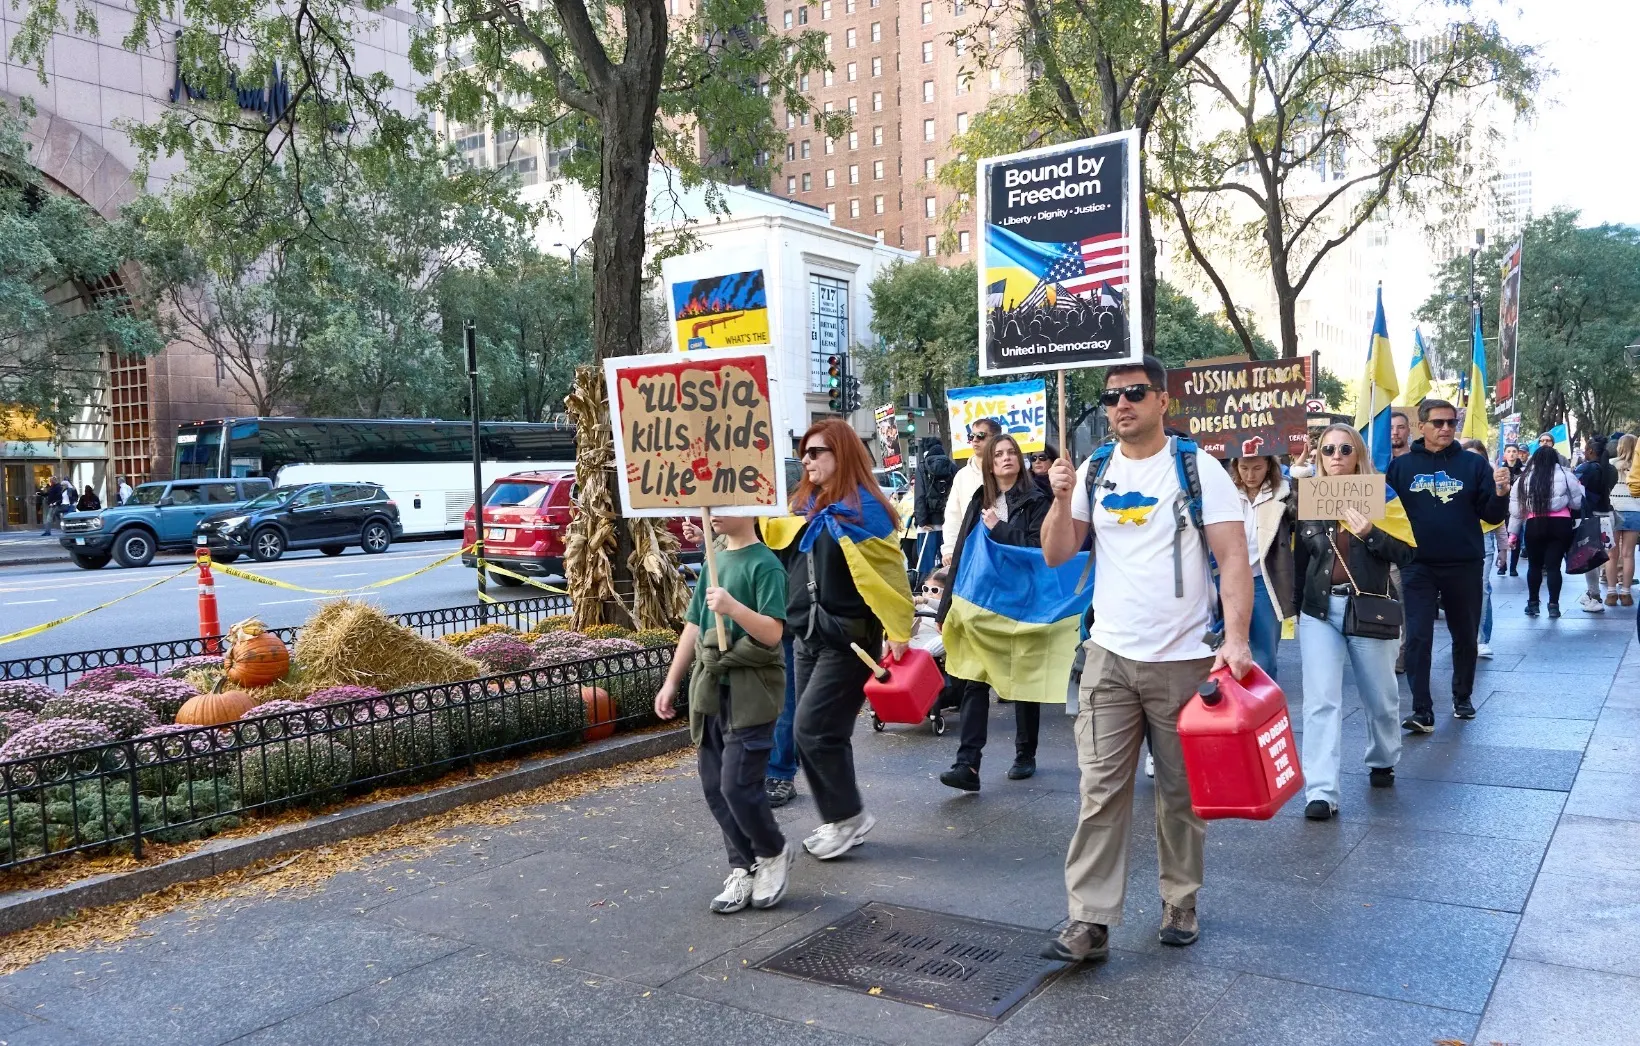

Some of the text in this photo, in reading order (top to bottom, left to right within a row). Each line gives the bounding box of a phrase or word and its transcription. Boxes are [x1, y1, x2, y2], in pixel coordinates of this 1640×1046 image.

[1005, 155, 1106, 188] Bound by
[1008, 179, 1101, 208] Freedom
[1003, 203, 1106, 226] Liberty Dignity Justice
[820, 287, 836, 301] 717
[820, 321, 838, 330] RETAIL
[824, 330, 834, 338] FOR
[725, 332, 766, 344] WHAT'S THE
[1002, 340, 1112, 356] United in Democracy
[1252, 364, 1306, 388] TERROR
[639, 372, 760, 413] russia
[1224, 388, 1306, 414] AMERICAN
[964, 400, 1008, 424] SAVE
[1190, 411, 1274, 434] DIESEL DEAL
[632, 410, 770, 453] kills kids
[712, 466, 760, 494] me
[1310, 480, 1340, 498] YOU
[1316, 499, 1344, 516] FOR
[1258, 716, 1289, 748] NO DEALS
[1268, 736, 1287, 758] WITH
[1274, 754, 1290, 772] THE
[1276, 766, 1296, 789] DEVIL
